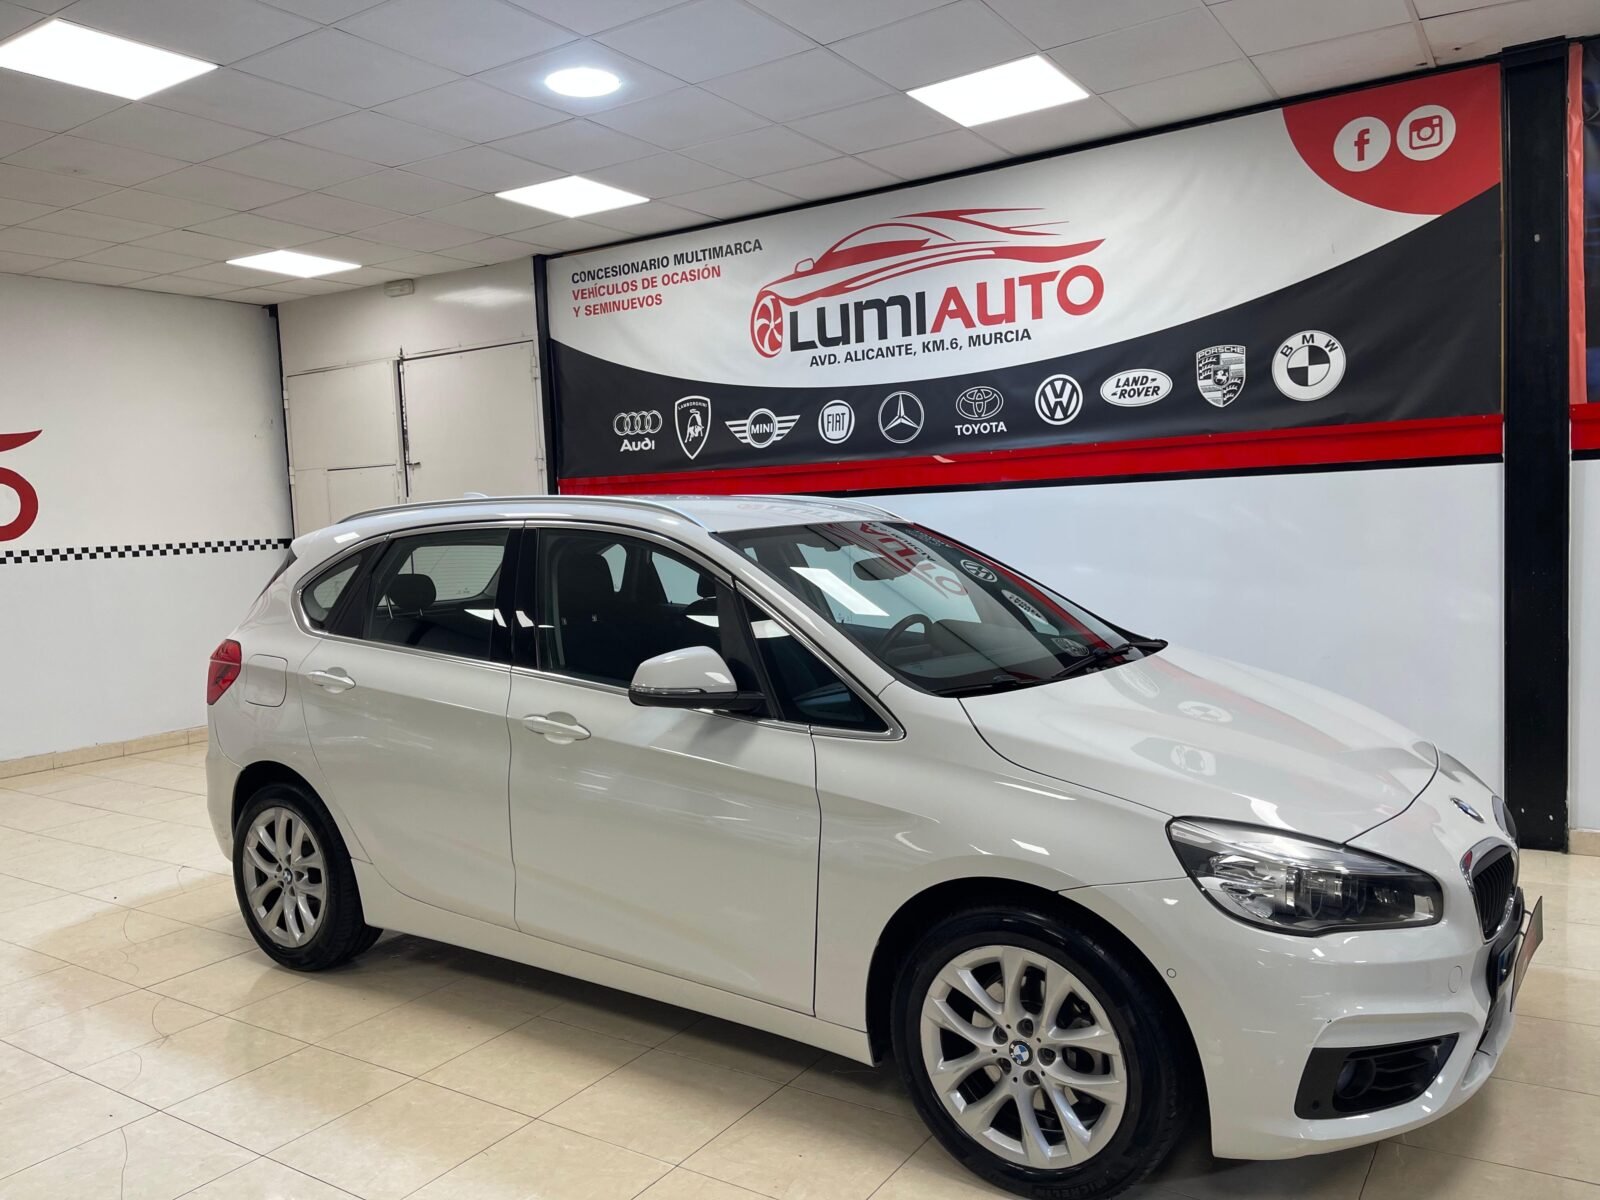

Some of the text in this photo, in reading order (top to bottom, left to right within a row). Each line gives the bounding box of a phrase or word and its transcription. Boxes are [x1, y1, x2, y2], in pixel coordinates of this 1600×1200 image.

[571, 238, 763, 284] CONCESIONARIO MULTIMARCA
[572, 264, 721, 301] VEHÍCULOS DE OCASIÓN
[573, 293, 663, 318] Y SEMINUEVOS
[809, 328, 1032, 367] AVD. ALICANTE, KM.6, MURCIA
[1198, 346, 1244, 358] PORSCHE
[1114, 375, 1149, 389] LAND
[750, 423, 774, 434] MINI
[826, 412, 846, 432] FIAT
[954, 421, 1007, 436] TOYOTA
[620, 437, 655, 452] Audi
